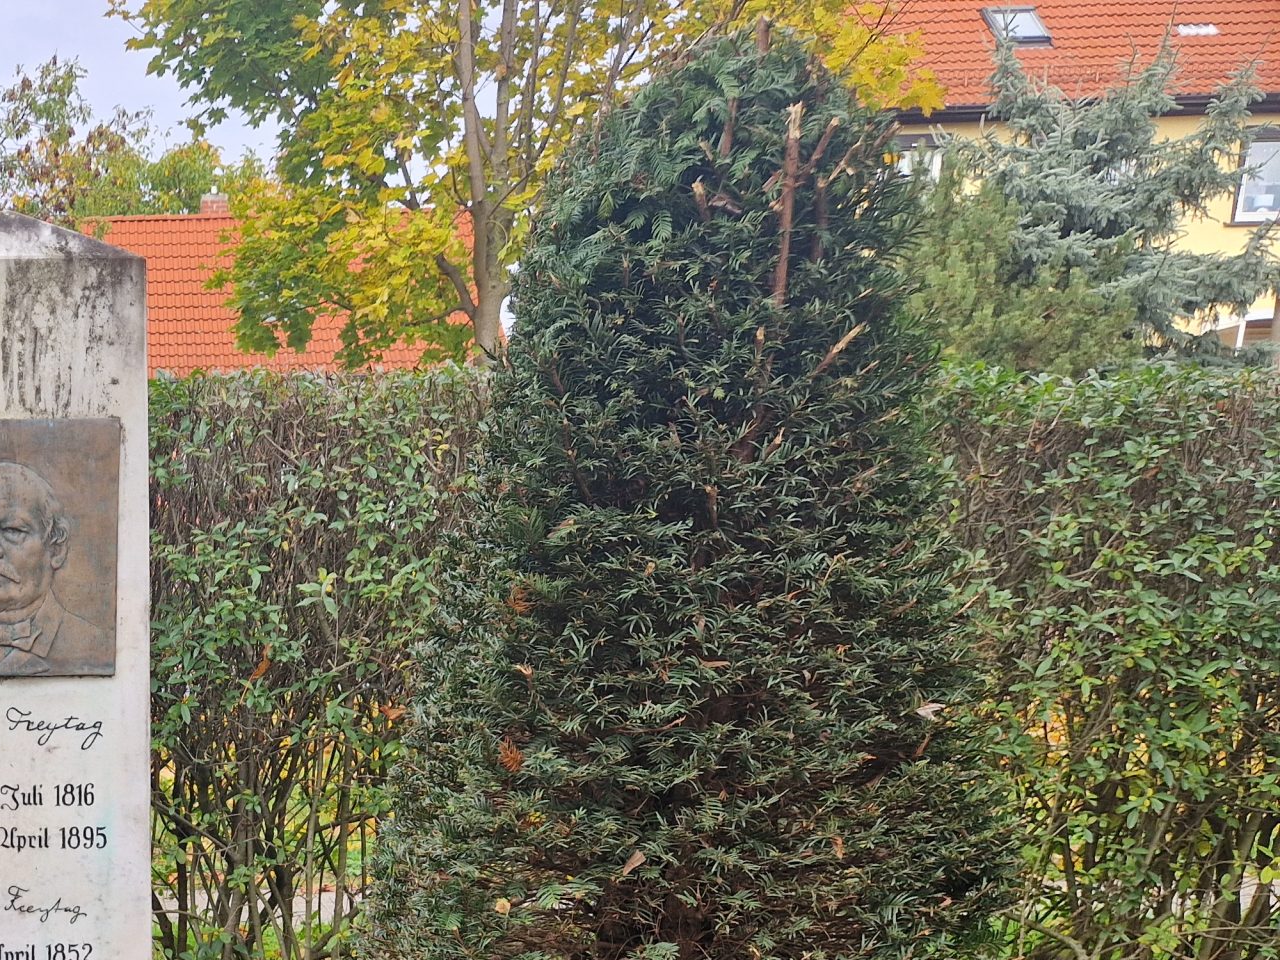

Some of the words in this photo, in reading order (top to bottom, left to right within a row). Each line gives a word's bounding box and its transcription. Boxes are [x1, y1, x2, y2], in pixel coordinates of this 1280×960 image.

[5, 706, 105, 750] Freytag
[0, 783, 44, 811] Juli
[53, 782, 95, 807] 1816
[58, 825, 108, 850] 1895
[3, 884, 88, 925] Freytag
